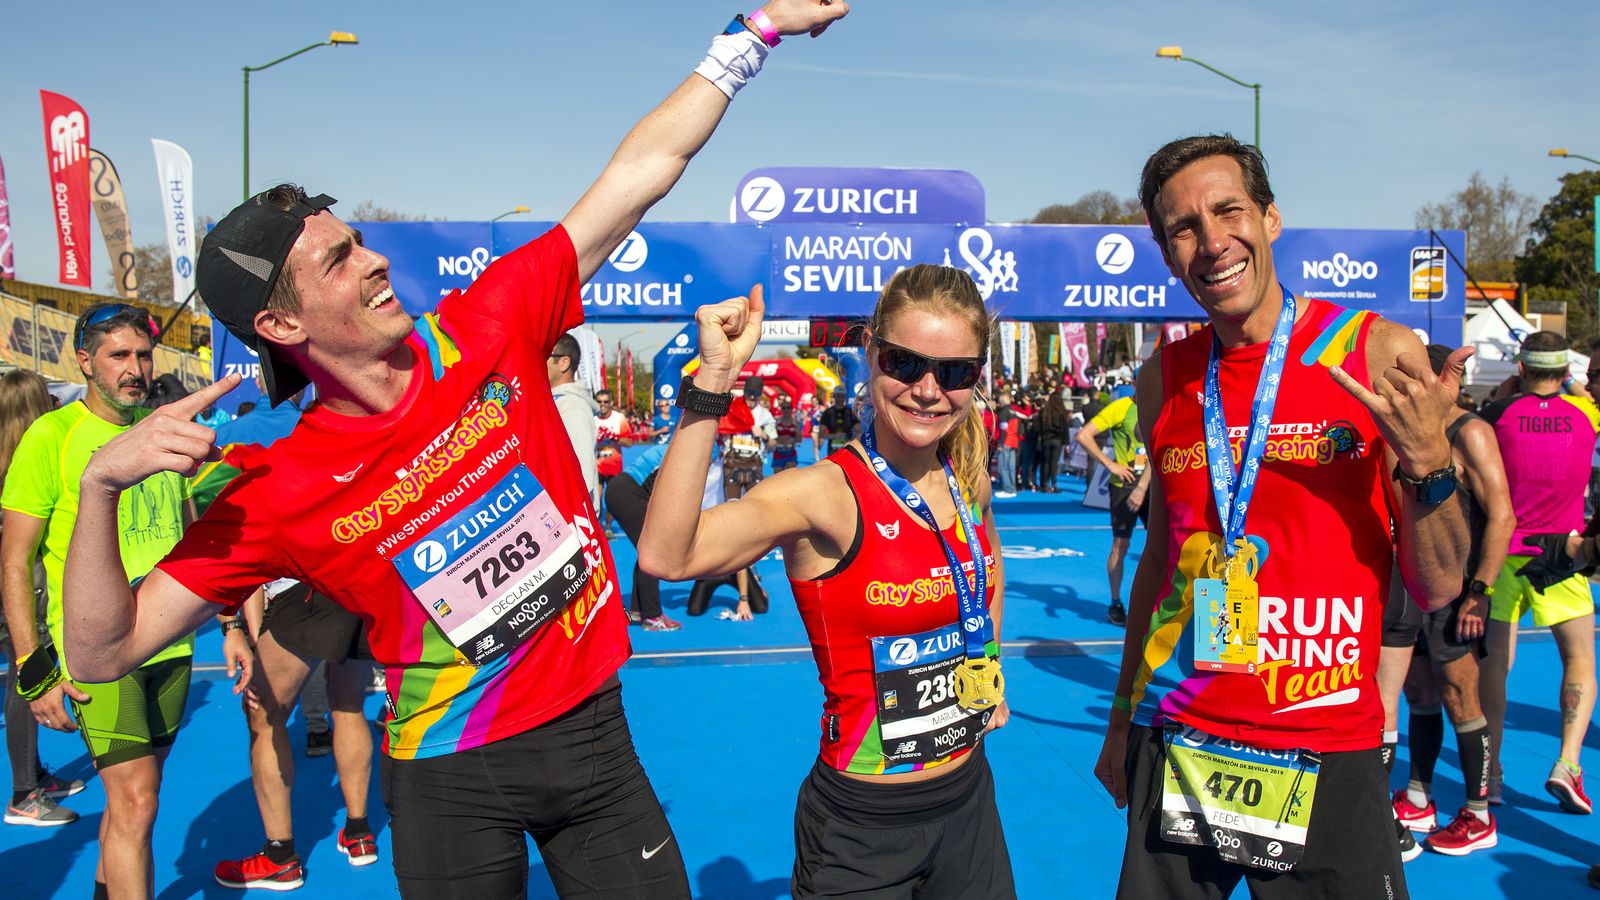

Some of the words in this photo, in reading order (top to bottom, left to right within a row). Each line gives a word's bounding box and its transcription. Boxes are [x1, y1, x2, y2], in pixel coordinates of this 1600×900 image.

[792, 188, 917, 214] ZURICH
[785, 232, 911, 260] MARATÓN
[580, 283, 682, 306] ZURICH
[1064, 284, 1166, 307] ZURICH
[1518, 416, 1572, 433] TIGRES
[376, 434, 520, 556] #WeShowYouTheWorld
[446, 483, 524, 550] ZURICH
[446, 560, 465, 576] ZURICH
[465, 543, 490, 564] MARATÓN
[489, 538, 498, 546] DE
[496, 524, 515, 540] SEVILLA
[514, 513, 525, 526] 2019
[554, 530, 561, 539] M
[462, 531, 540, 600] 7263
[492, 579, 534, 616] DECLAN
[533, 570, 548, 587] M.
[563, 566, 590, 600] ZURICH
[866, 580, 912, 607] City
[954, 565, 967, 595] SEVILLA
[962, 595, 971, 613] 2019
[1259, 596, 1363, 634] RUN
[484, 643, 504, 656] balance
[923, 632, 964, 655] ZUR
[1258, 637, 1360, 667] NING
[1248, 664, 1254, 672] 5
[1254, 658, 1363, 705] Team
[1192, 752, 1212, 761] ZURICH
[1212, 757, 1238, 768] MARATÓN
[1248, 764, 1270, 773] SEVILLA
[1202, 770, 1262, 807] 470
[1213, 810, 1240, 826] FEDE
[1251, 856, 1293, 871] ZURICH
